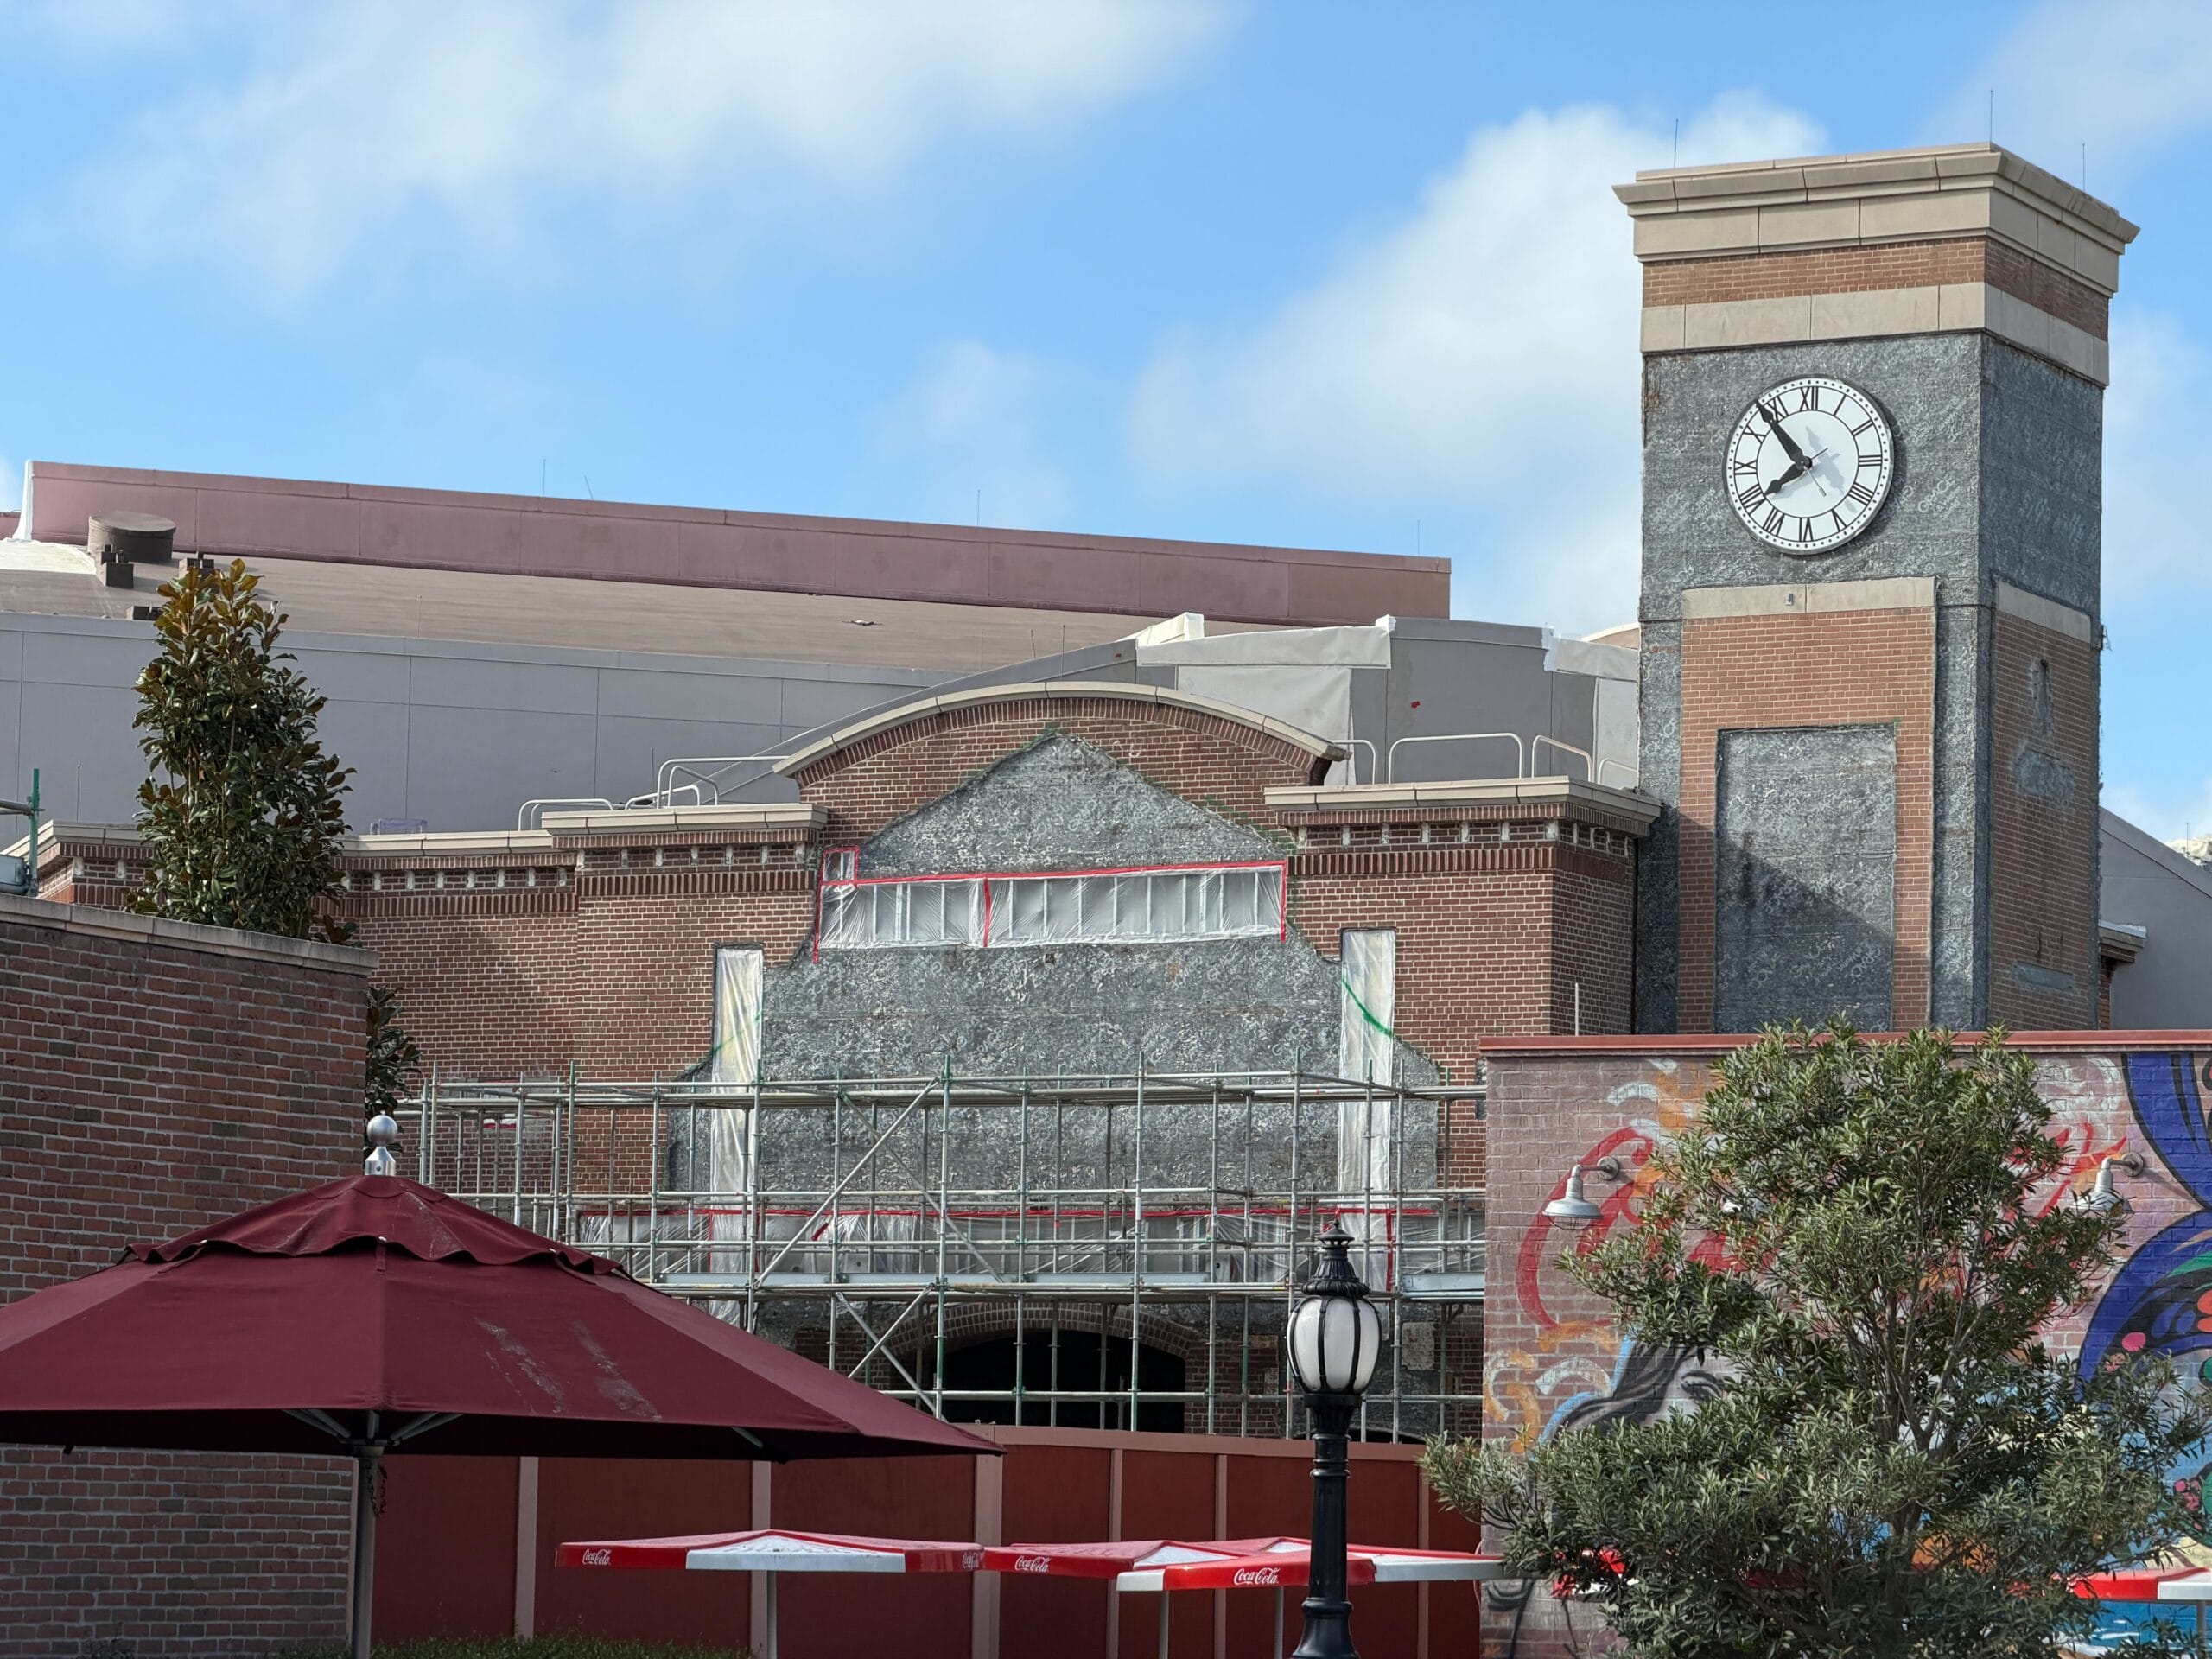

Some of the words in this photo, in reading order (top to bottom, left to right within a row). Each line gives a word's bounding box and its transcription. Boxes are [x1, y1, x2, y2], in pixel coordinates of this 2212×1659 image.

[1799, 386, 1819, 411] XII
[1742, 424, 1766, 443] X
[1851, 419, 1874, 437] II
[1733, 459, 1758, 475] IX
[1858, 454, 1883, 467] III
[1738, 483, 1767, 515] VIII
[1762, 506, 1785, 537] VII
[1798, 518, 1814, 542] VI
[1831, 509, 1847, 532] V
